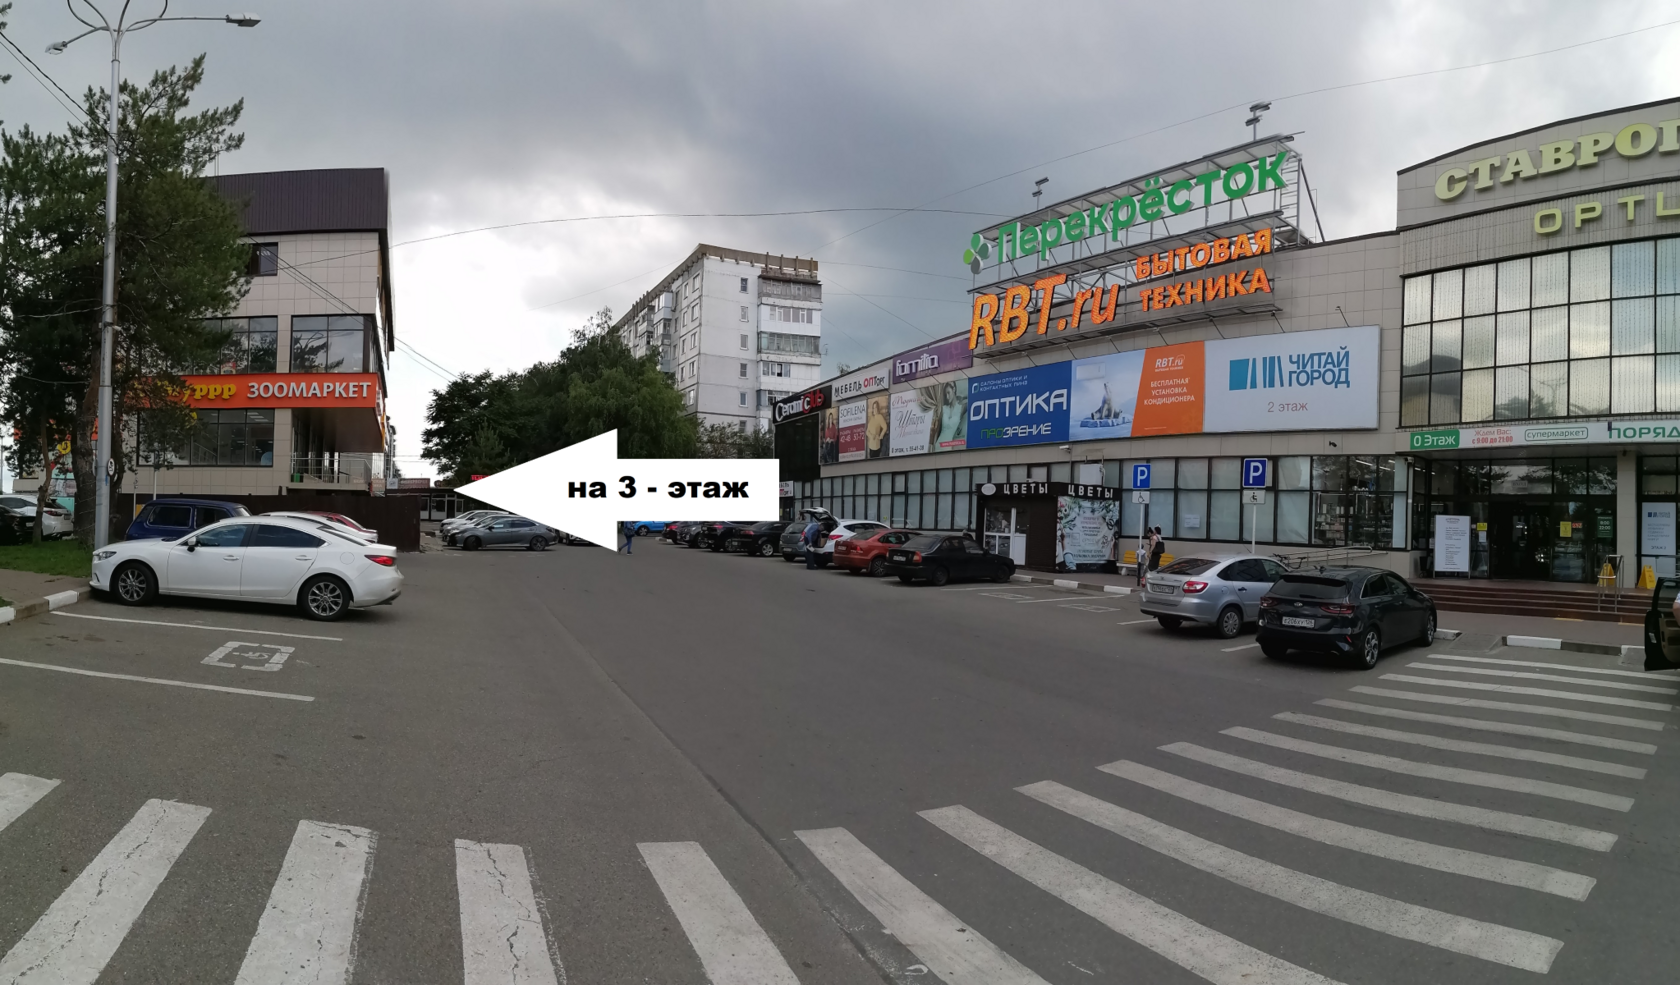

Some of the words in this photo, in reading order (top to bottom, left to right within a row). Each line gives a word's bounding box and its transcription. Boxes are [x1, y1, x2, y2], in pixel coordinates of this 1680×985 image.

[998, 151, 1287, 263] Перекрёсток
[1136, 227, 1271, 280] БЫТОВАЯ
[1139, 267, 1271, 312] ТЕХНИКА
[968, 272, 1120, 350] RBT.ru
[895, 353, 939, 377] familia
[1155, 357, 1184, 368] RBT.ru
[1288, 346, 1350, 369] ЧИТАЙ
[980, 379, 1002, 387] САЛОНЫ
[1002, 376, 1022, 384] ОПТИКИ
[1288, 368, 1351, 388] ГОРОД
[247, 382, 371, 398] ЗООМАРКЕТ
[833, 381, 862, 397] МЕБЕЛЬ
[980, 383, 1012, 392] КОНТАКТНЫХ
[1151, 387, 1188, 396] УСТАНОВКА
[970, 388, 1068, 421] ОПТИКА
[1144, 395, 1195, 406] КОНДИЦИОНЕРА
[1267, 402, 1275, 412] 2
[1278, 402, 1308, 412] этаж
[840, 404, 866, 418] SOFILENA
[981, 422, 1052, 439] ПРОЗРЕНИЕ
[1496, 428, 1512, 436] Вас:
[1527, 429, 1585, 438] супермаркет
[1414, 436, 1421, 446] 0
[1424, 434, 1456, 446] Этаж
[1498, 435, 1513, 443] 21:00
[1137, 467, 1148, 486] P
[1249, 462, 1262, 484] P
[1003, 483, 1048, 494] ЦВЕТЫ
[1068, 484, 1113, 498] ЦВЕТЫ
